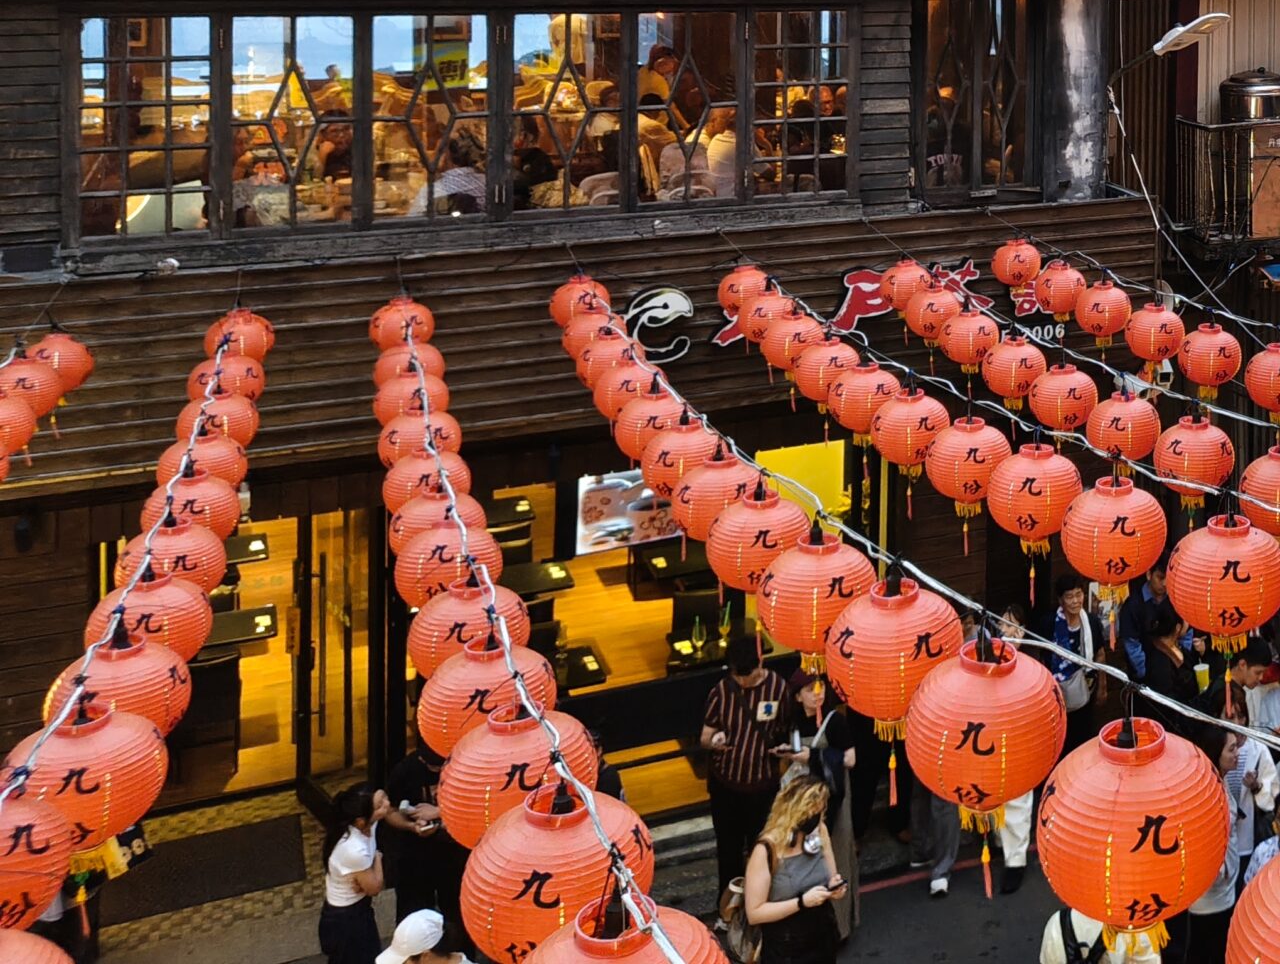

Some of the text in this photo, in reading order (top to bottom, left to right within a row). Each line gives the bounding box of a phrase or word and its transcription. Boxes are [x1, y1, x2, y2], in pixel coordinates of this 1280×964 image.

[1011, 254, 1026, 281] 九份
[923, 302, 939, 333] 九份
[1090, 302, 1104, 333] 九份
[1157, 323, 1174, 356] 九份
[1017, 357, 1033, 393] 九份
[1215, 346, 1232, 381] 九份
[875, 383, 891, 396] 九
[1063, 387, 1083, 426] 九份
[644, 416, 664, 430] 九
[962, 448, 986, 495] 九份
[179, 499, 204, 515] 九
[1016, 477, 1042, 532] 九份
[1105, 516, 1137, 576] 九份
[172, 555, 198, 572] 九
[1218, 560, 1251, 628] 九份
[131, 613, 162, 633] 九
[444, 622, 475, 643] 九
[911, 632, 944, 661] 九
[462, 688, 498, 714] 九
[500, 762, 544, 791] 九
[951, 721, 997, 806] 九份
[1126, 814, 1181, 924] 九份
